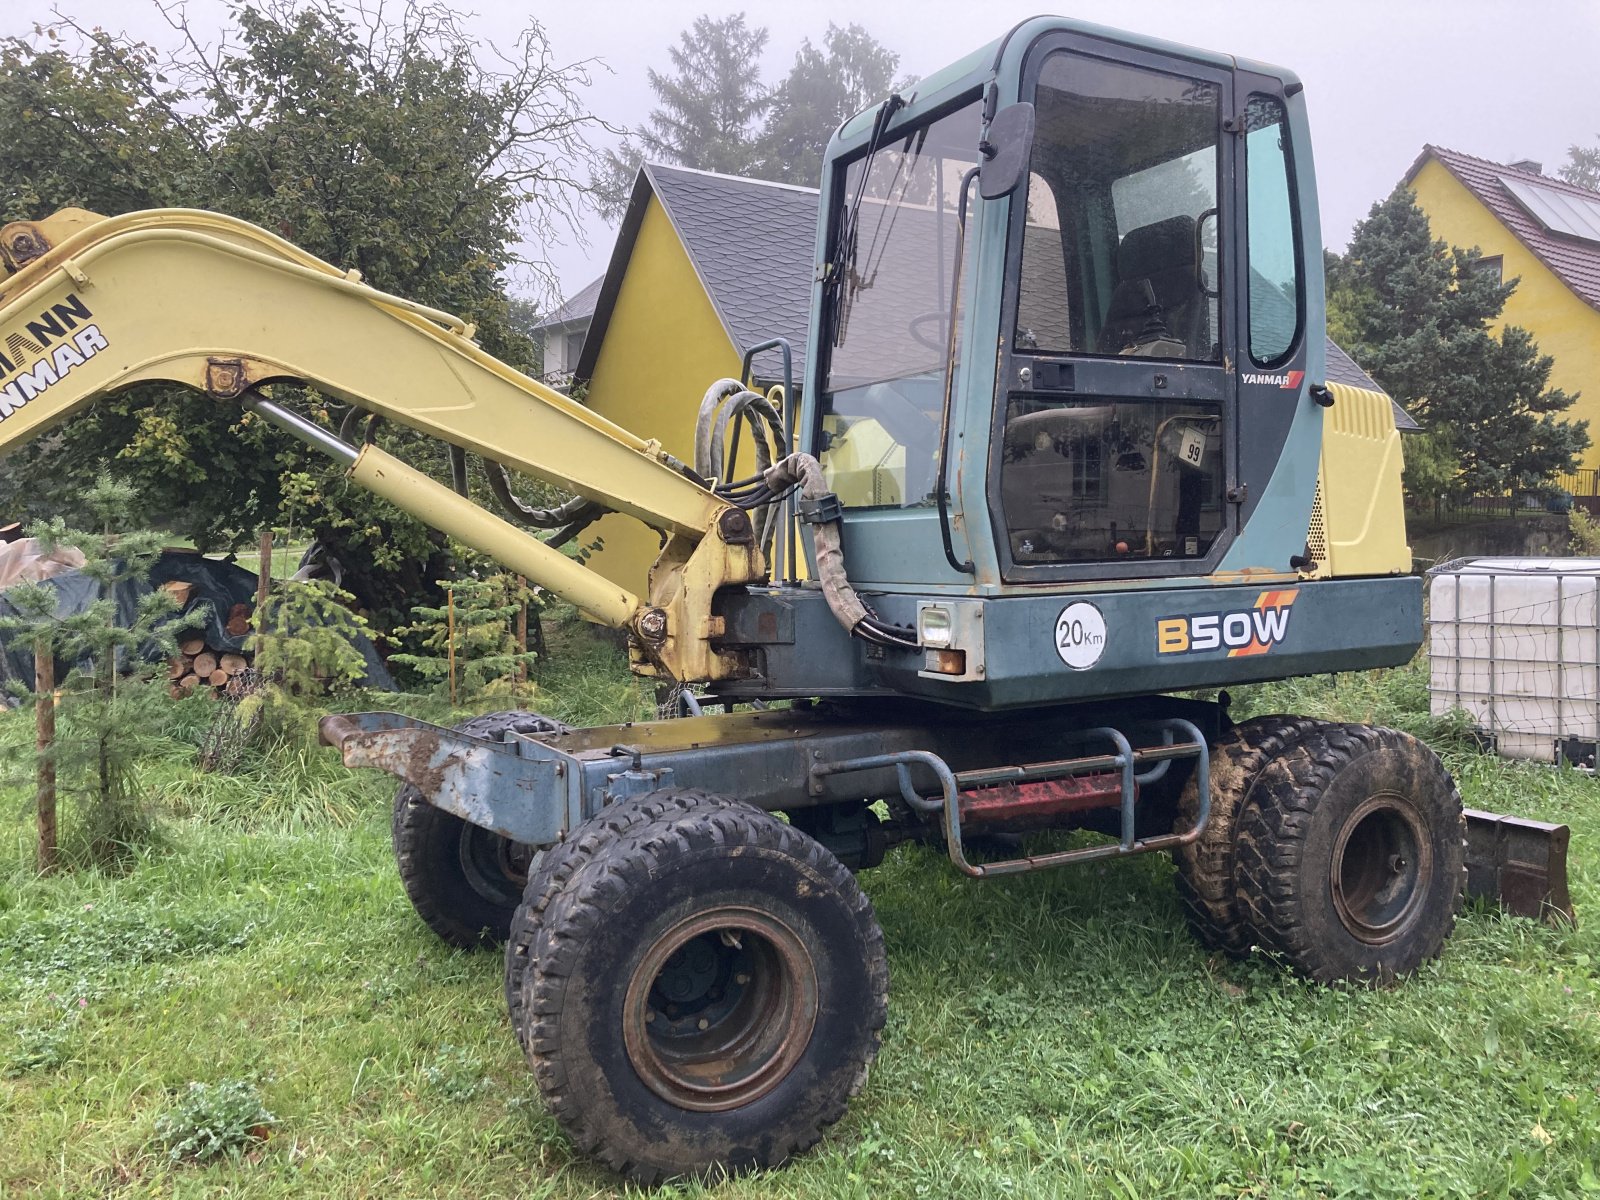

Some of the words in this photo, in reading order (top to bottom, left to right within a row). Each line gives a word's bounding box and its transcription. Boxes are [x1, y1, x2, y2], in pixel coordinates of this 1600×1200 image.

[0, 324, 109, 422] NMAR
[1241, 373, 1290, 386] YANMAR
[1187, 444, 1200, 462] 99
[1157, 608, 1291, 654] B50W
